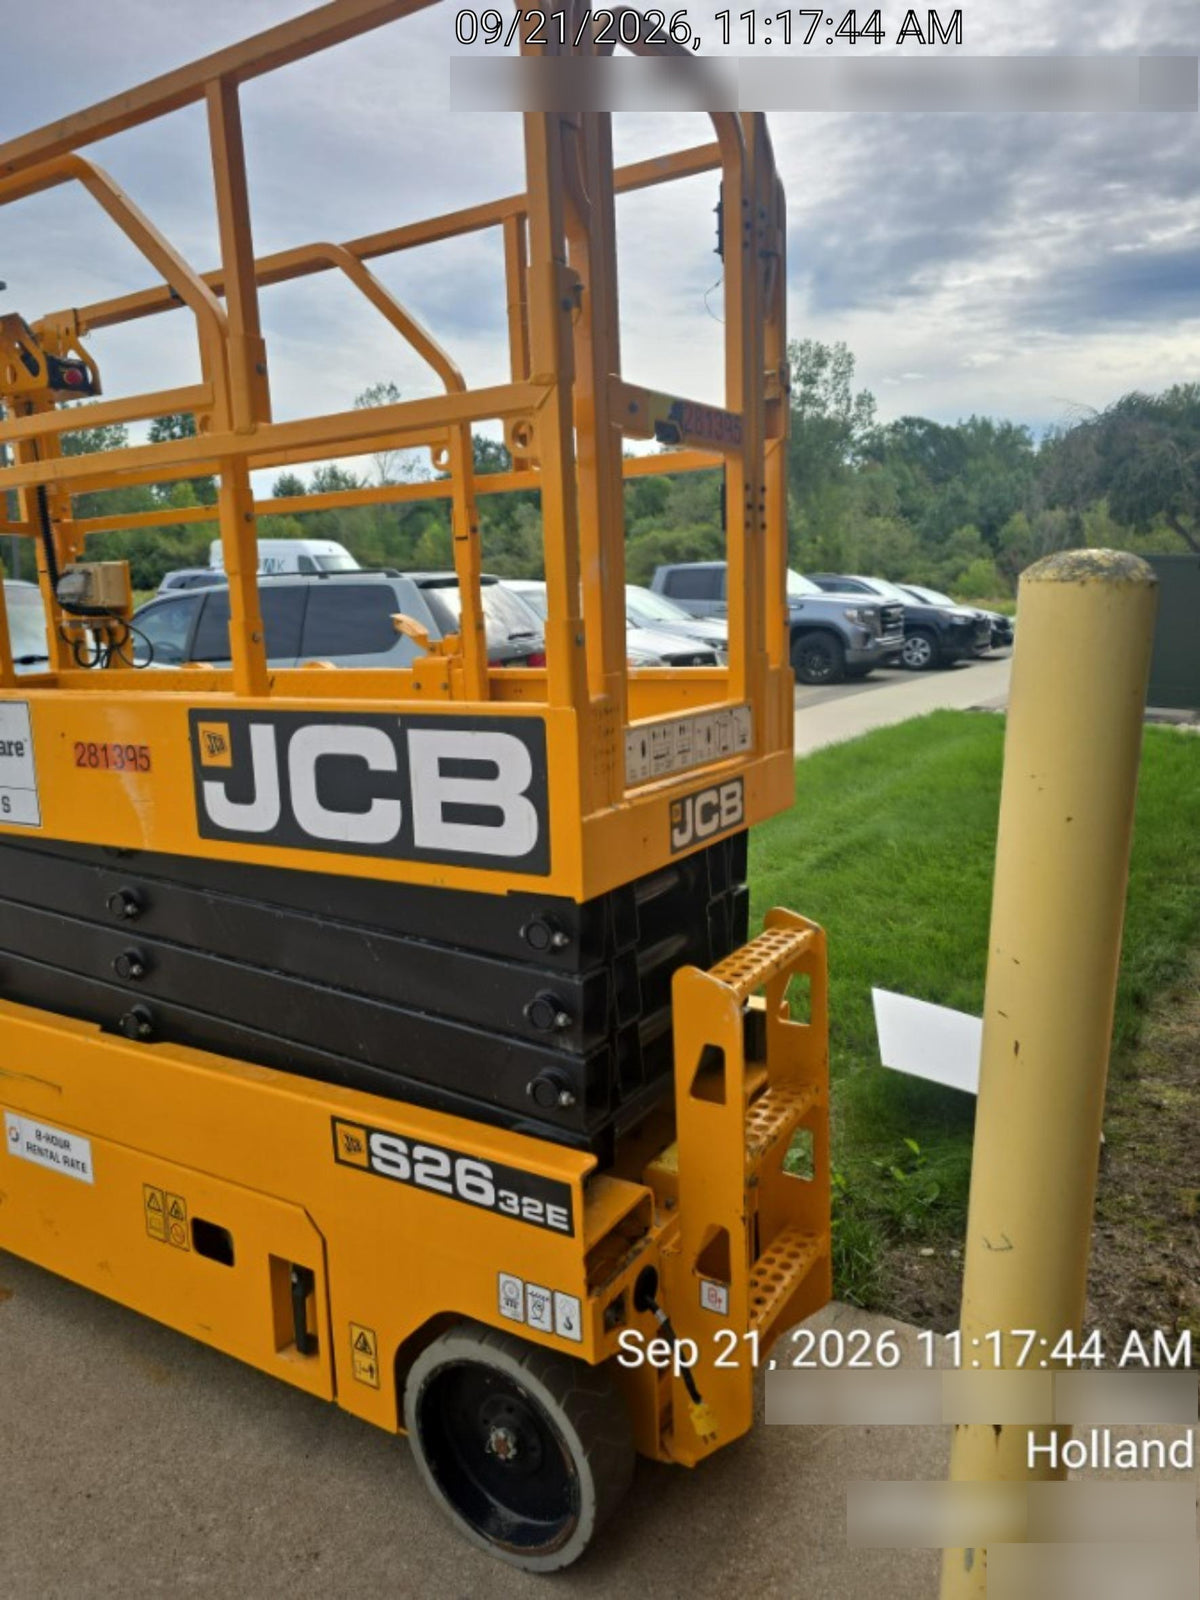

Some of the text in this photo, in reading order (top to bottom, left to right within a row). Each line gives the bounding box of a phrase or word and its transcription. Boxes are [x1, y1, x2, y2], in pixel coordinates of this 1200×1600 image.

[73, 741, 152, 772] 281395
[202, 722, 540, 858] JCB
[672, 780, 743, 849] JCB
[26, 1141, 88, 1174] RENTAL RATE
